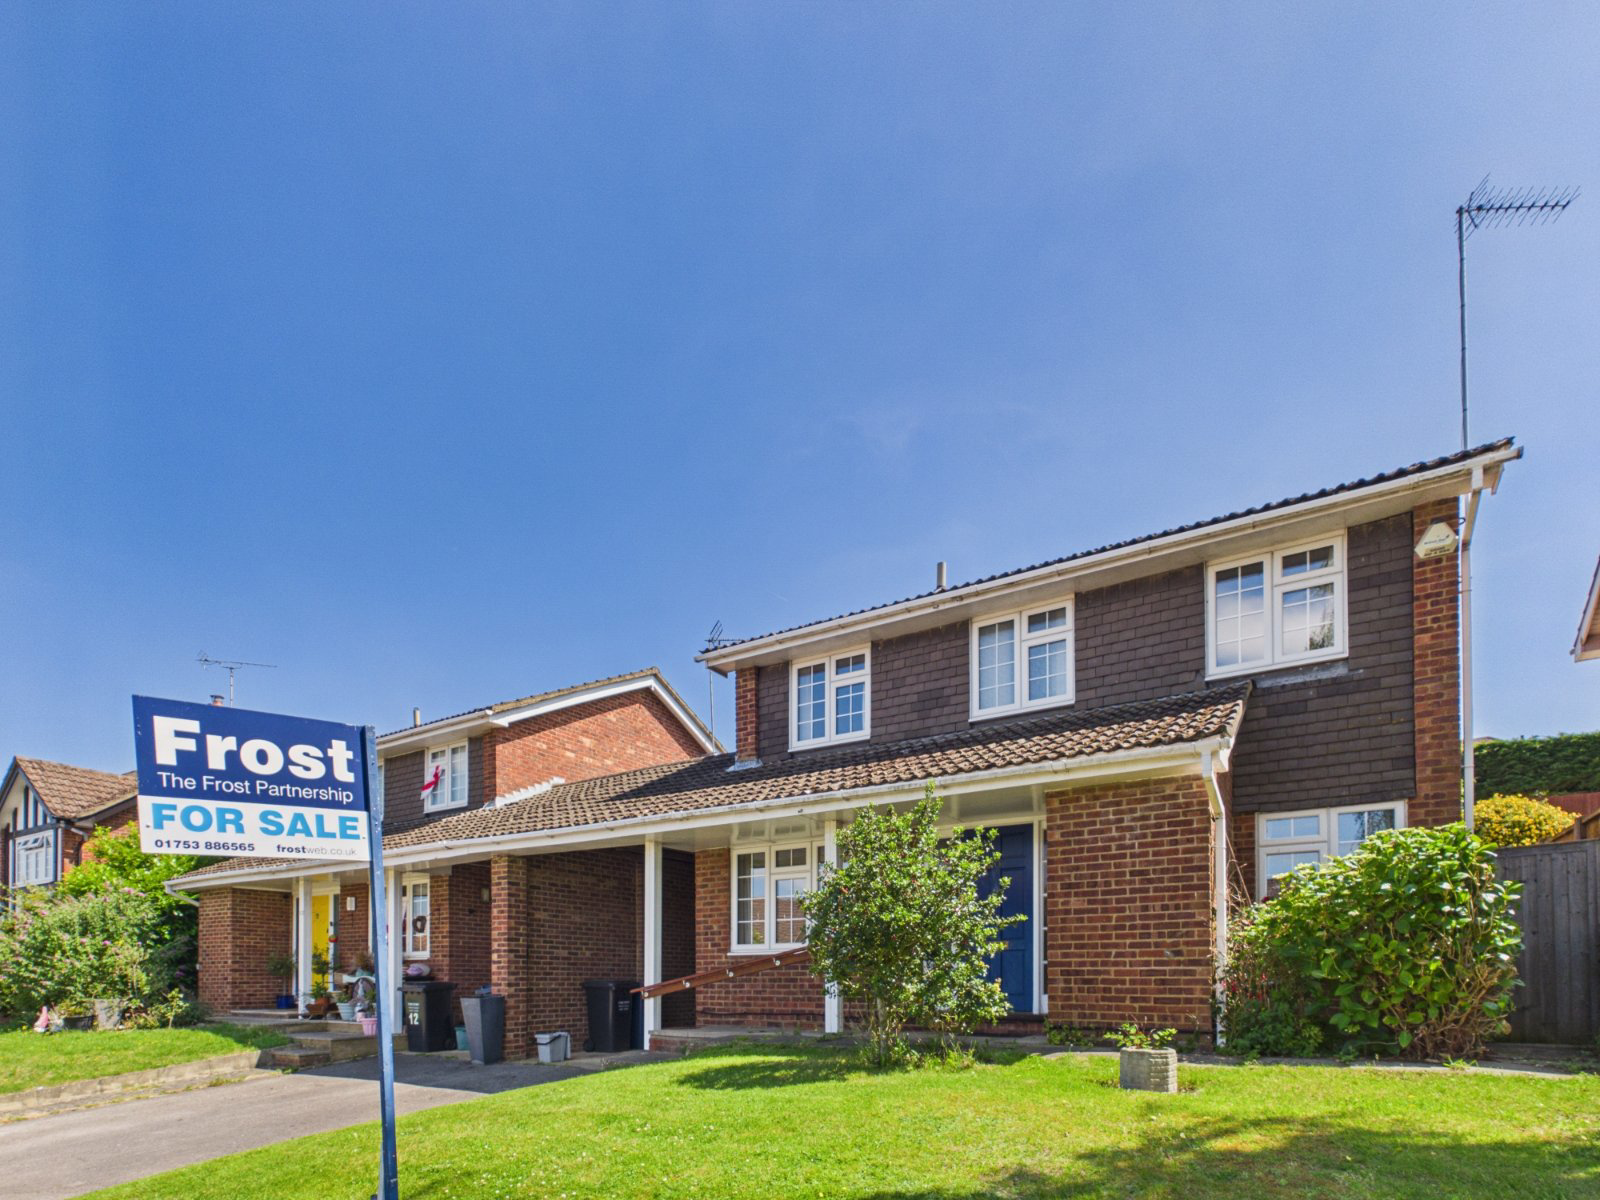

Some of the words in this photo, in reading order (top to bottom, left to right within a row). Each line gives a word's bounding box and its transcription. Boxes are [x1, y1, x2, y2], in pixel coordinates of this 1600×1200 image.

[152, 715, 355, 783] Frost
[157, 771, 197, 791] The
[202, 775, 251, 795] Frost
[256, 780, 353, 805] Partnership
[151, 803, 245, 835] FOR
[259, 809, 361, 840] SALE
[155, 839, 200, 849] 01753
[205, 841, 255, 851] 886565
[276, 844, 357, 856] frostweb.co.uk
[408, 1012, 420, 1025] 12
